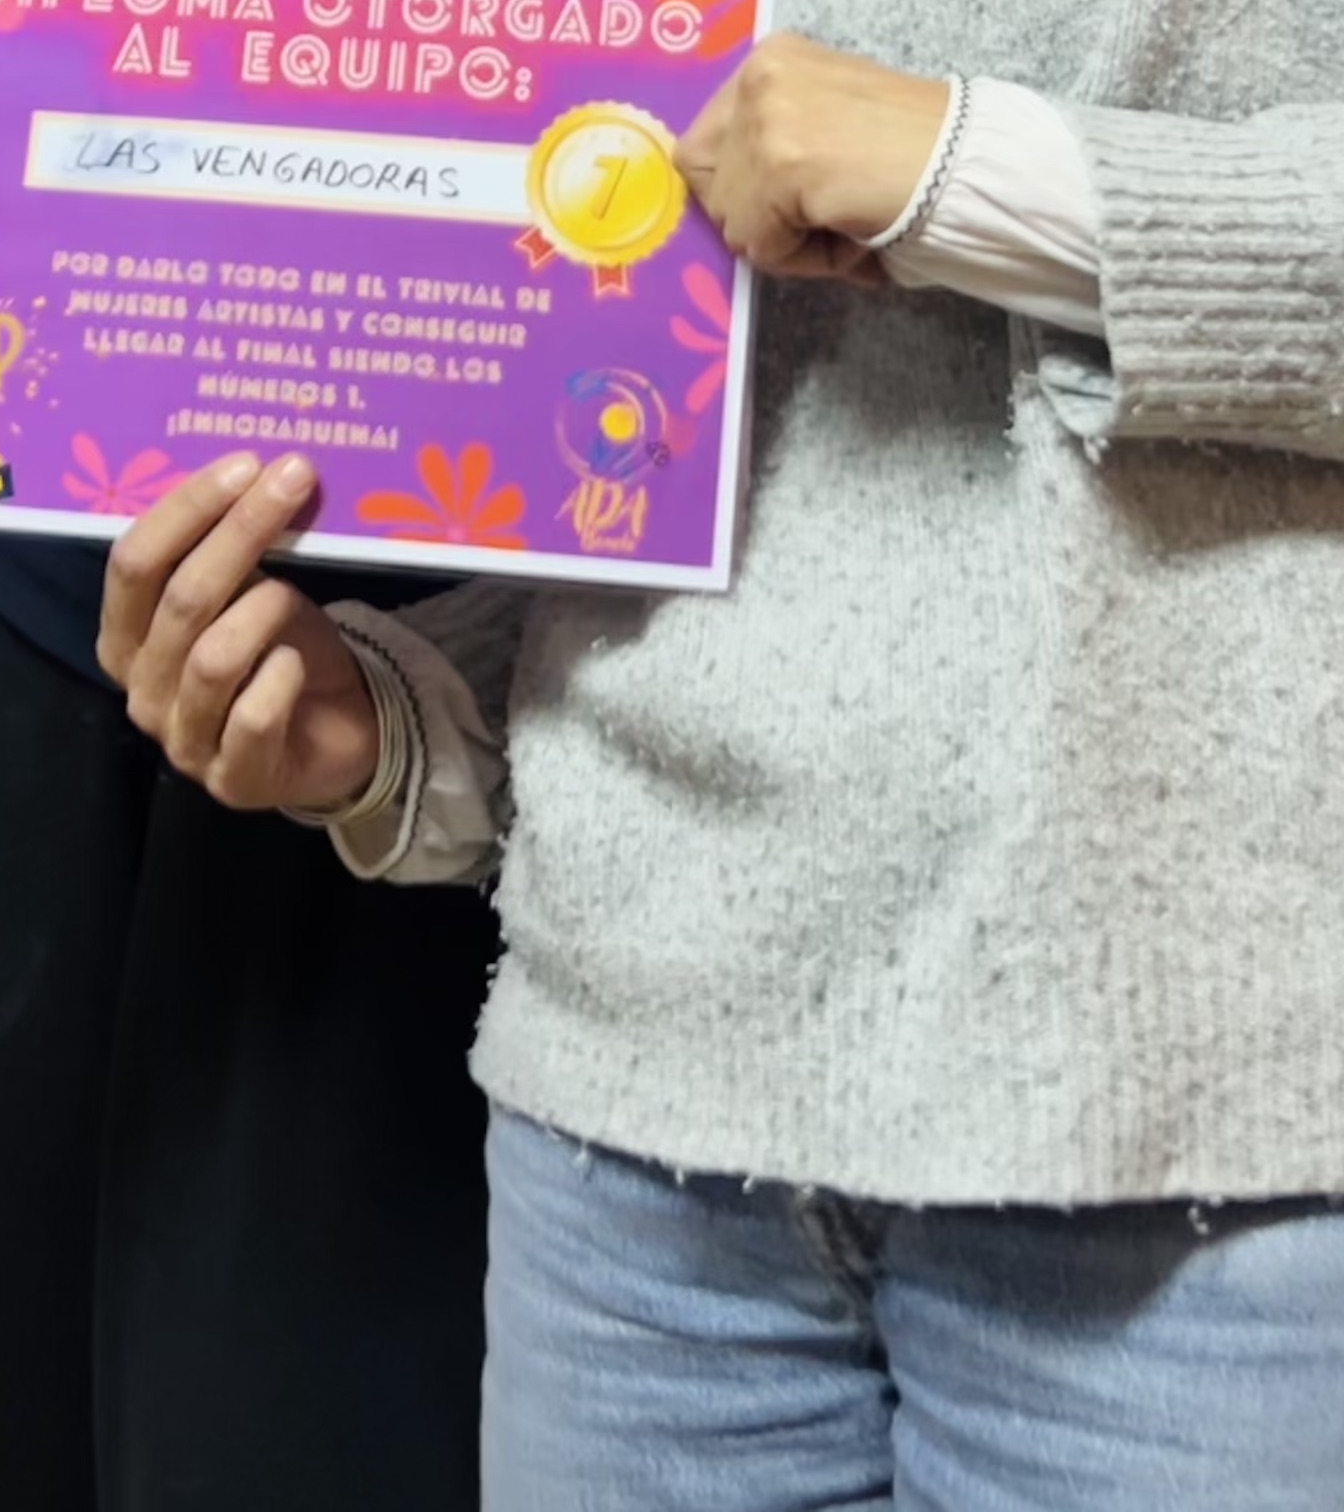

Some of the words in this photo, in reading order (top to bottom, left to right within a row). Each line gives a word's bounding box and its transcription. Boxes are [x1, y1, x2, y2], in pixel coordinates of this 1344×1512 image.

[112, 22, 191, 78] AL
[241, 30, 532, 101] EQUIPO:
[75, 132, 160, 174] LAS
[192, 145, 459, 198] VENGADORAS
